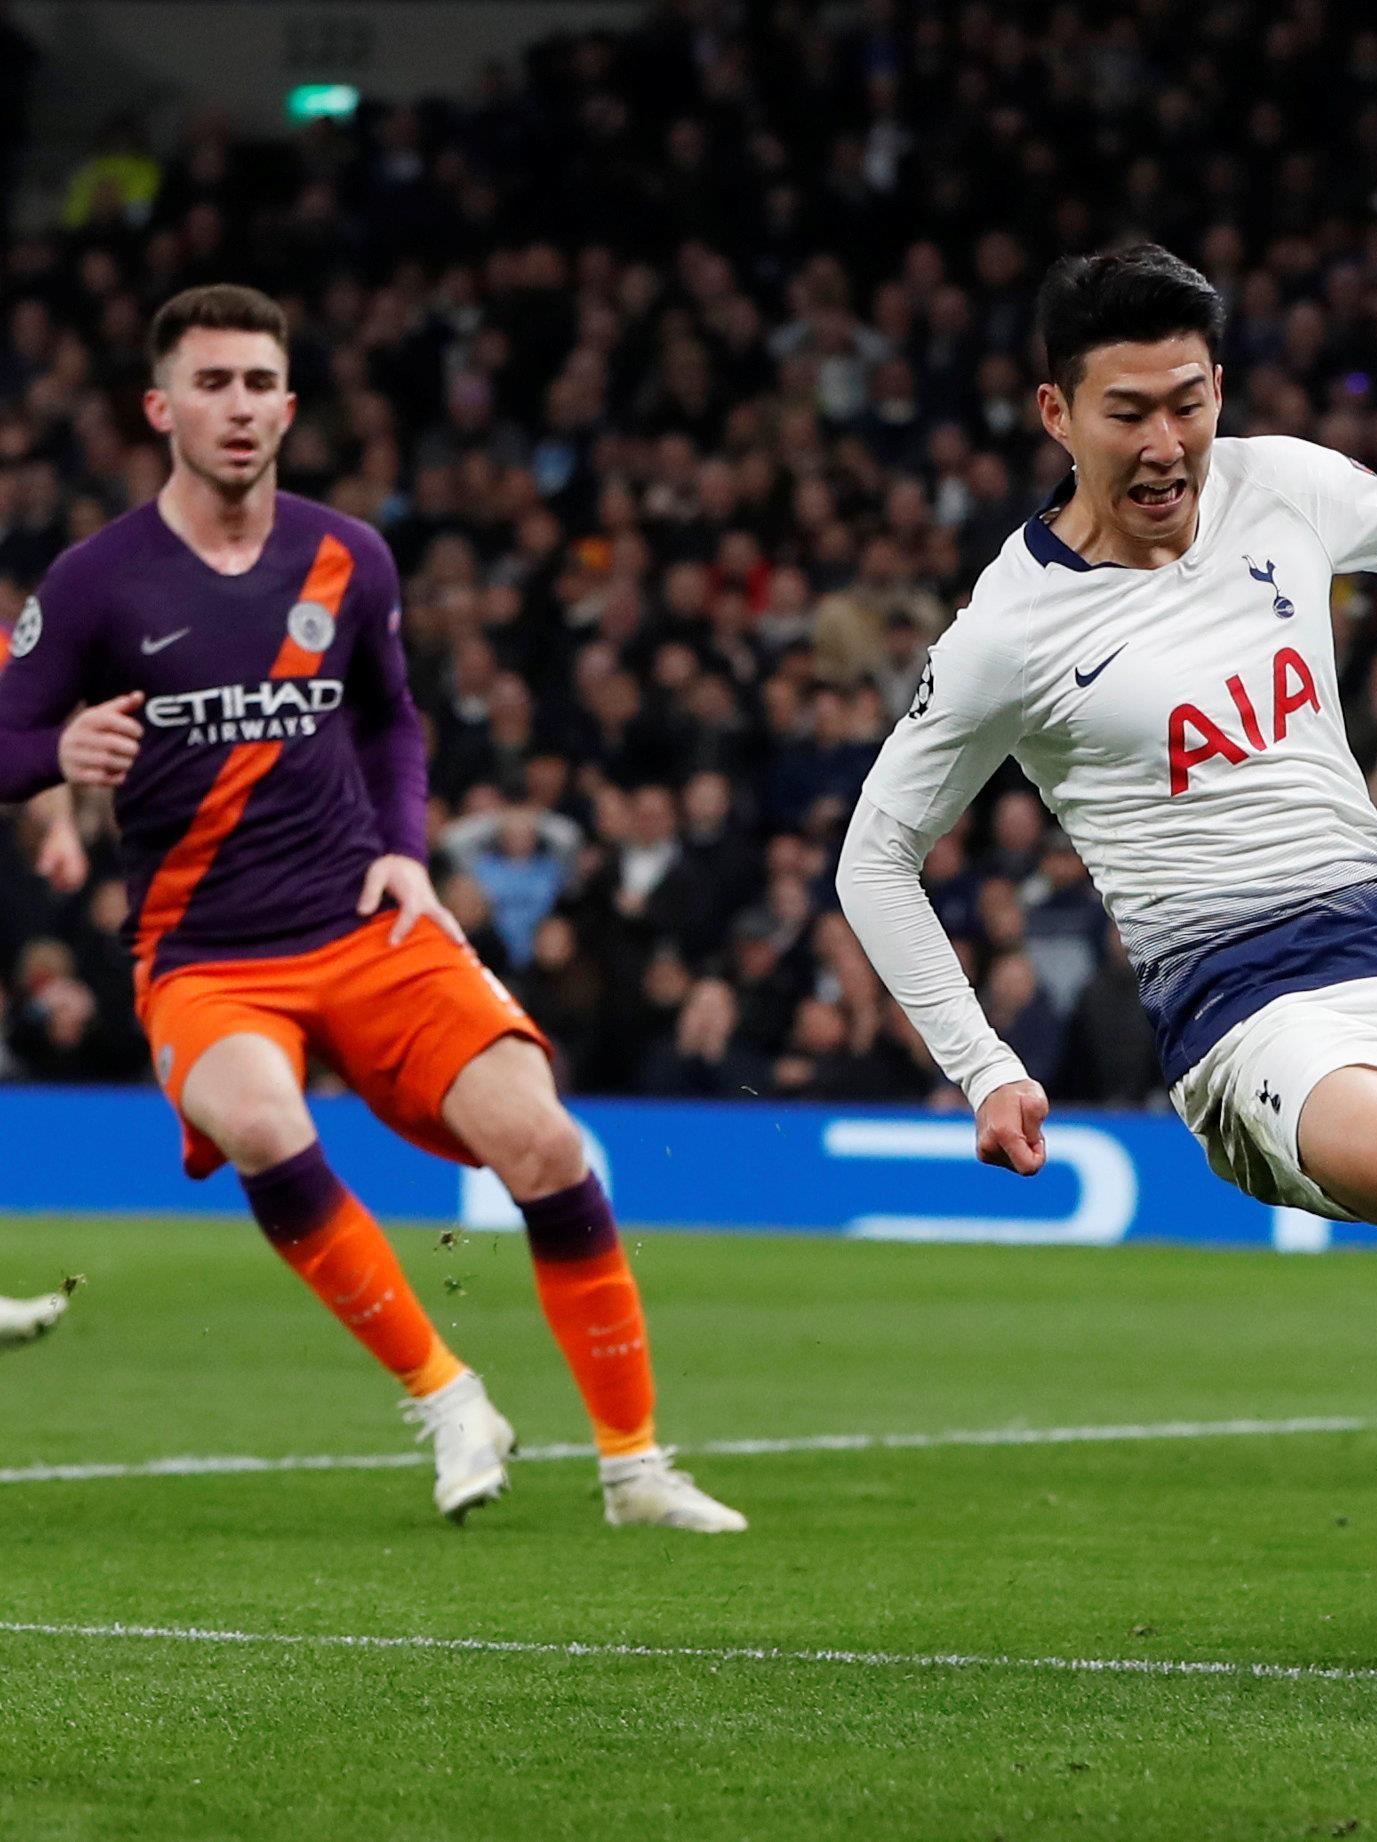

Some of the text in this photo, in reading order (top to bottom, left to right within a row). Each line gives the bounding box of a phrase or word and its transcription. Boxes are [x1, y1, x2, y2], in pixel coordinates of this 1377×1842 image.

[145, 679, 344, 728] ETIHAD
[1169, 647, 1322, 797] AIA
[187, 715, 317, 746] AIRWAYS
